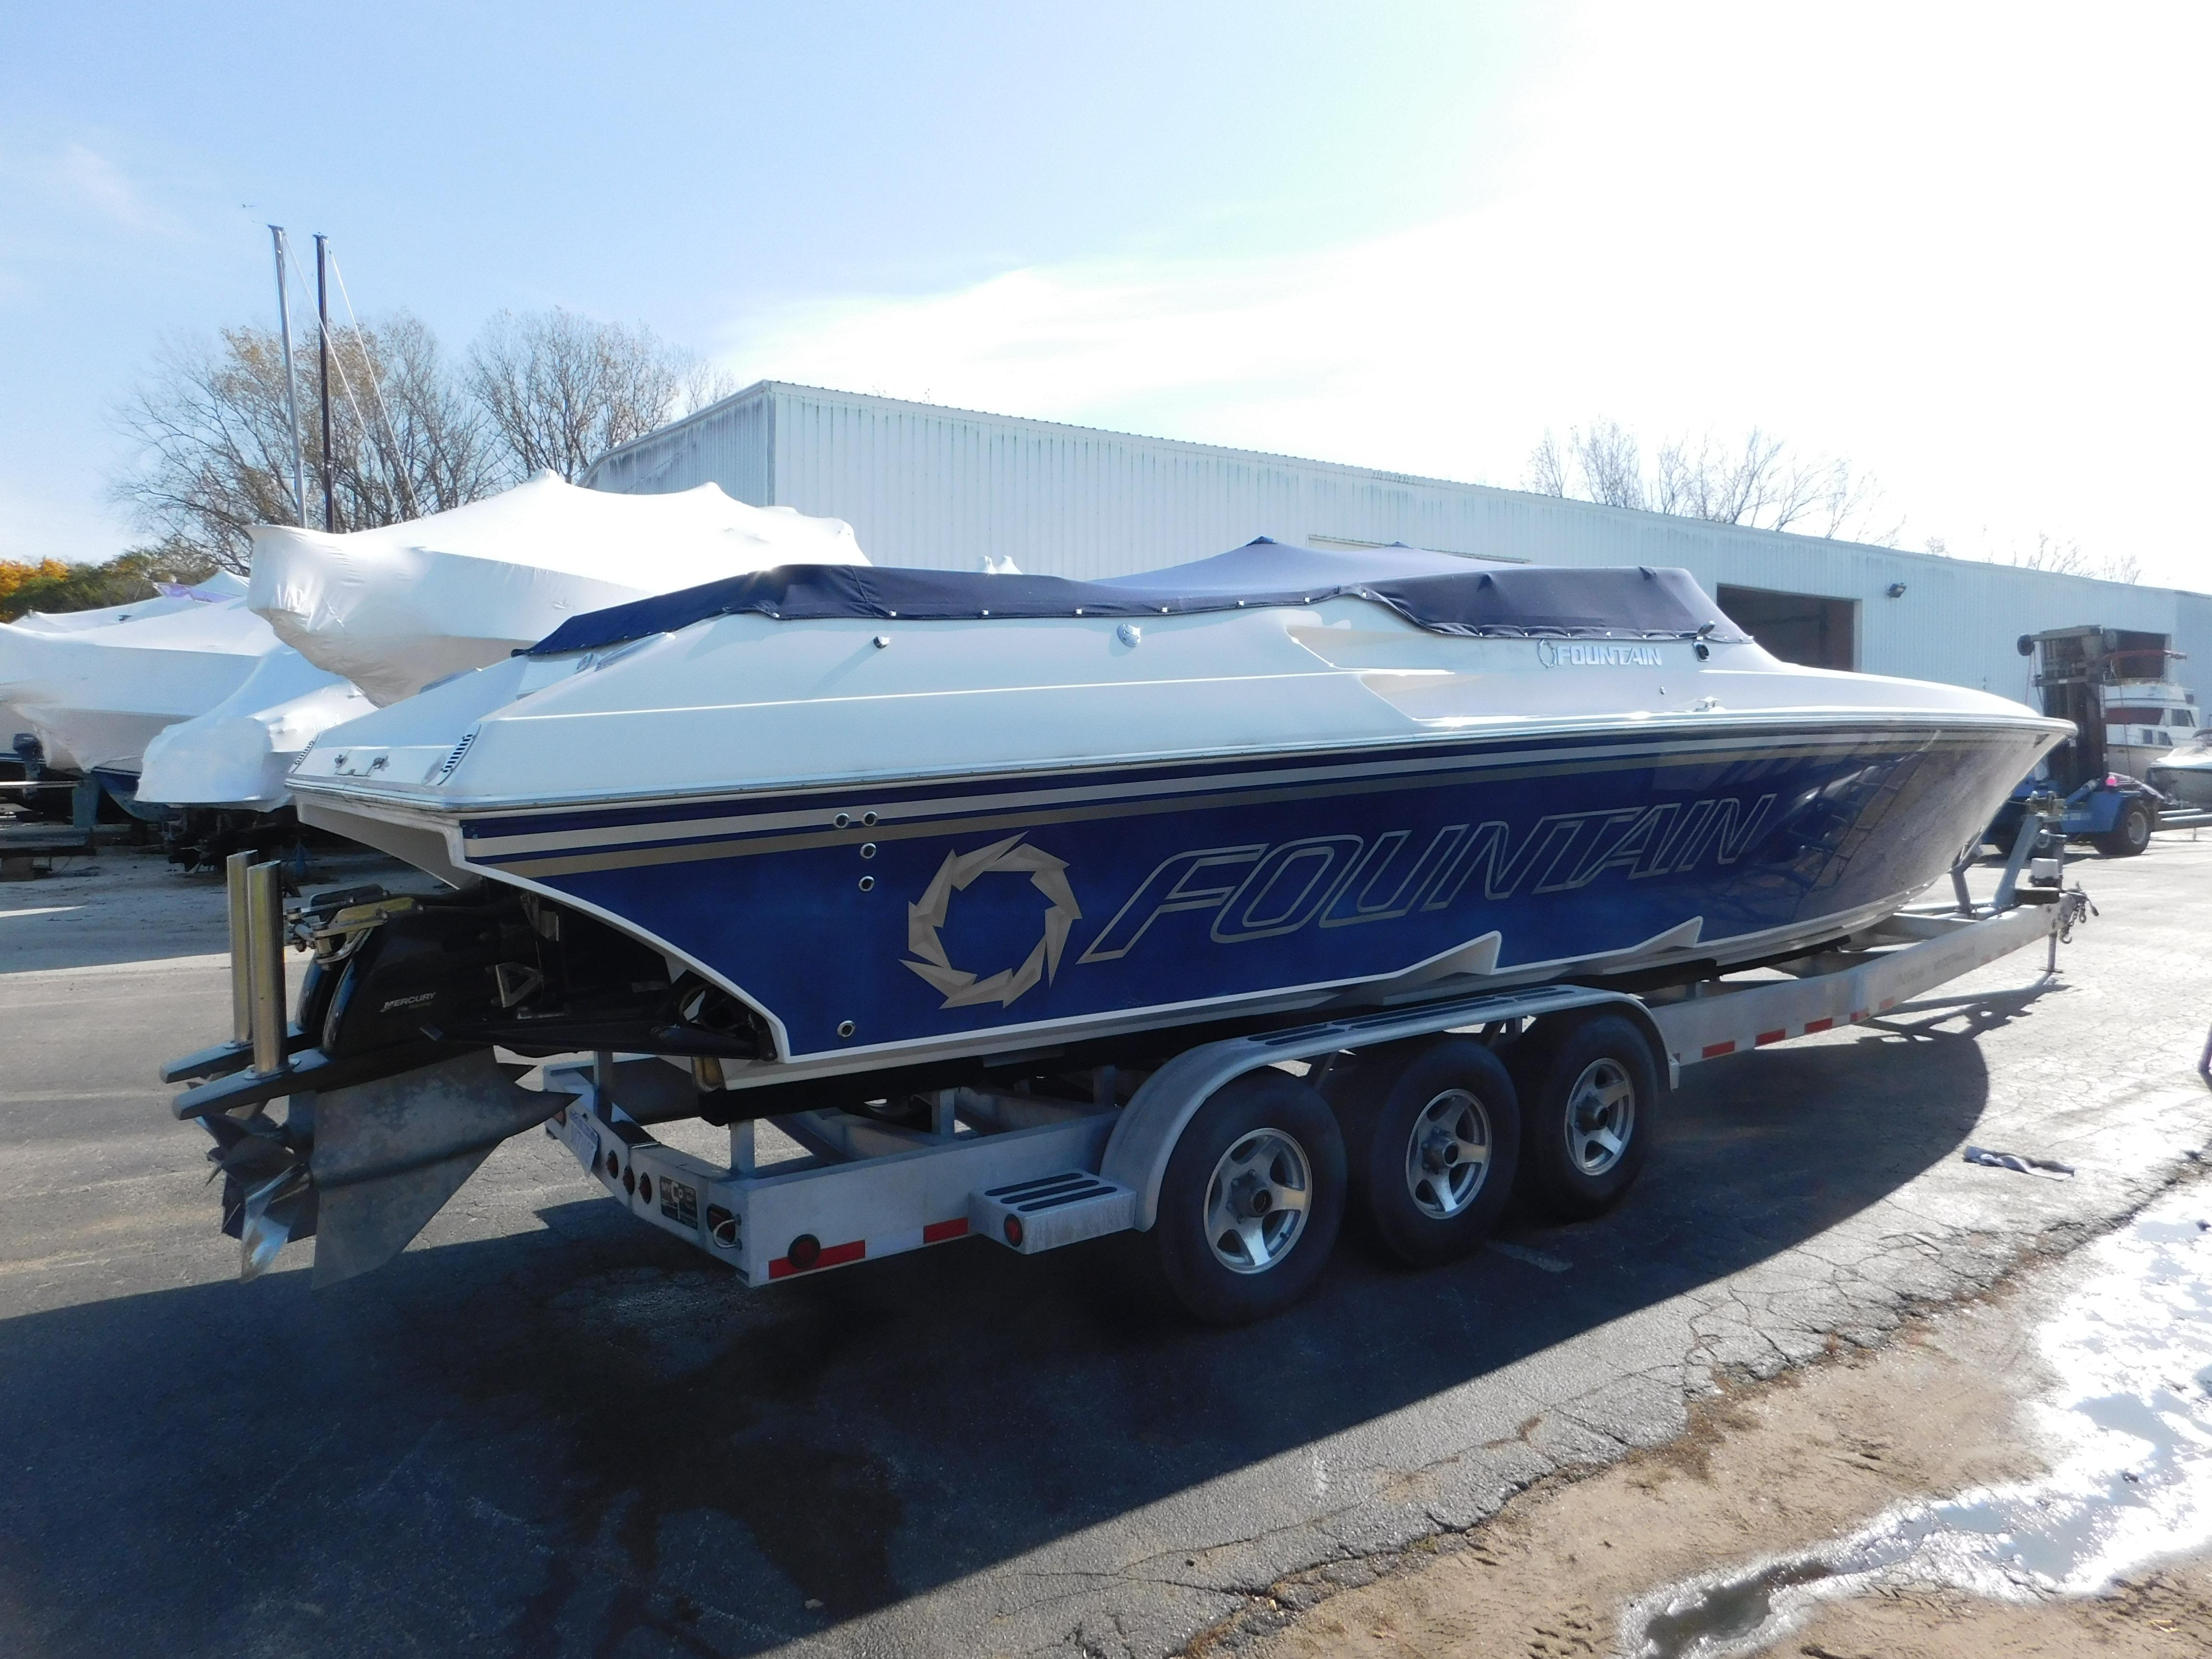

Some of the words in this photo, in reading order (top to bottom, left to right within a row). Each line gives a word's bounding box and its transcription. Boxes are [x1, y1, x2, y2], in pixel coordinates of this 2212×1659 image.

[1557, 646, 1663, 666] FOUNTAIN
[1077, 793, 1777, 964] FOUNTAIN
[379, 992, 436, 1012] MERCURY
